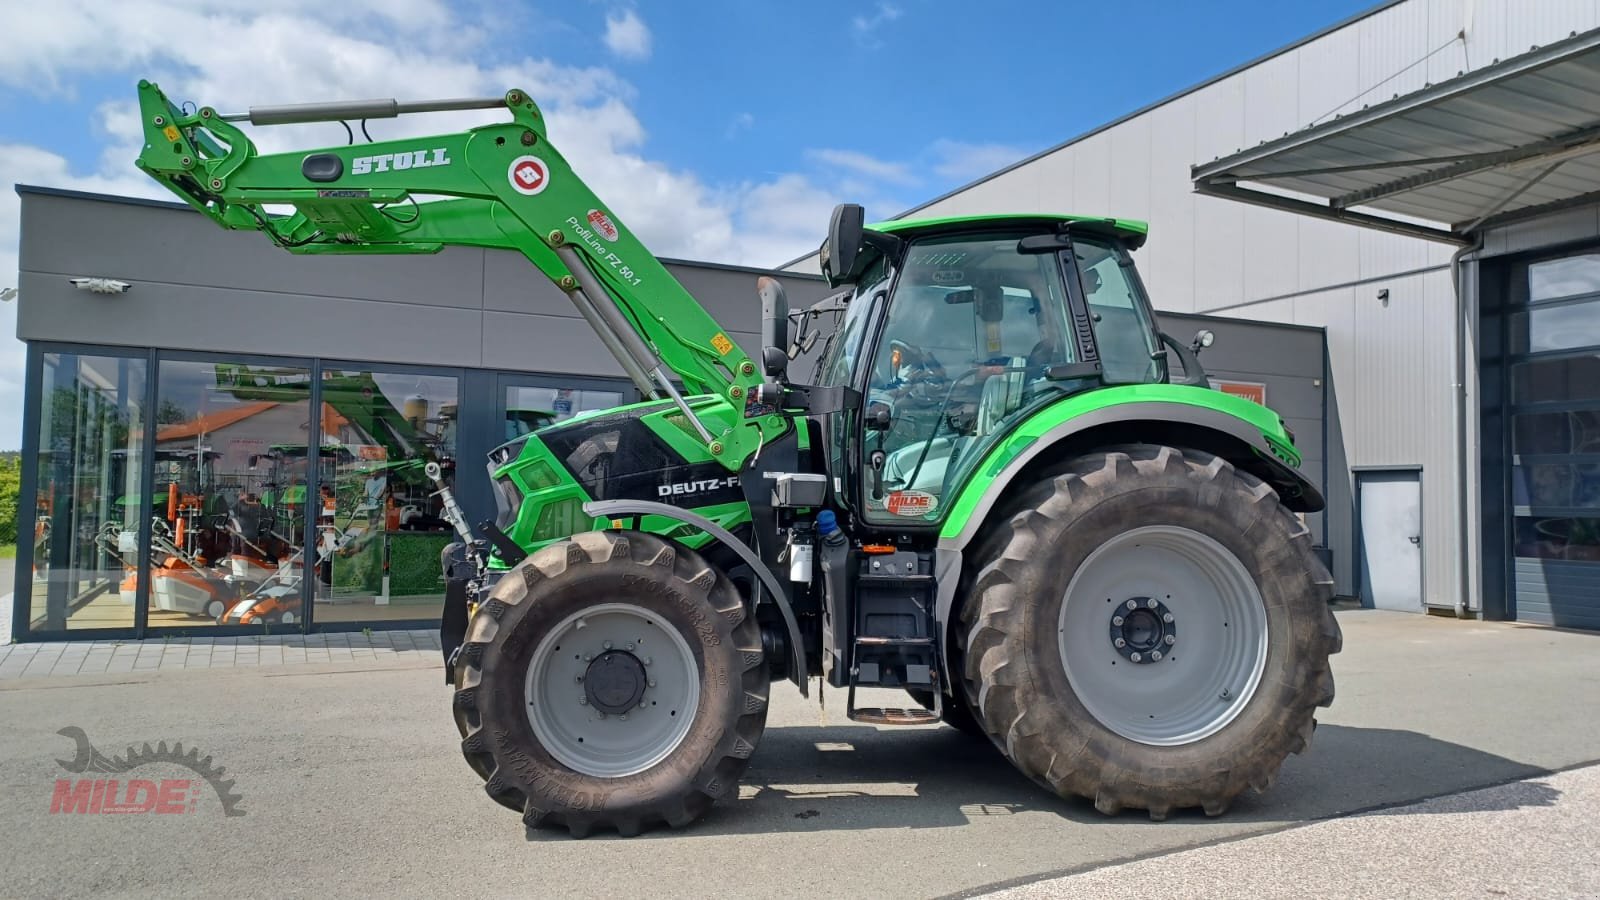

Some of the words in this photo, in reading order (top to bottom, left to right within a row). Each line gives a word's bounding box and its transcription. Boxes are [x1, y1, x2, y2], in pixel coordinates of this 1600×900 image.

[352, 148, 450, 175] STOLL
[591, 210, 616, 236] MILDE
[566, 216, 606, 254] ProfiLine
[605, 252, 622, 269] FZ
[619, 266, 642, 286] 50.1
[658, 476, 741, 497] DEUTZ-F
[889, 496, 929, 506] MILDE
